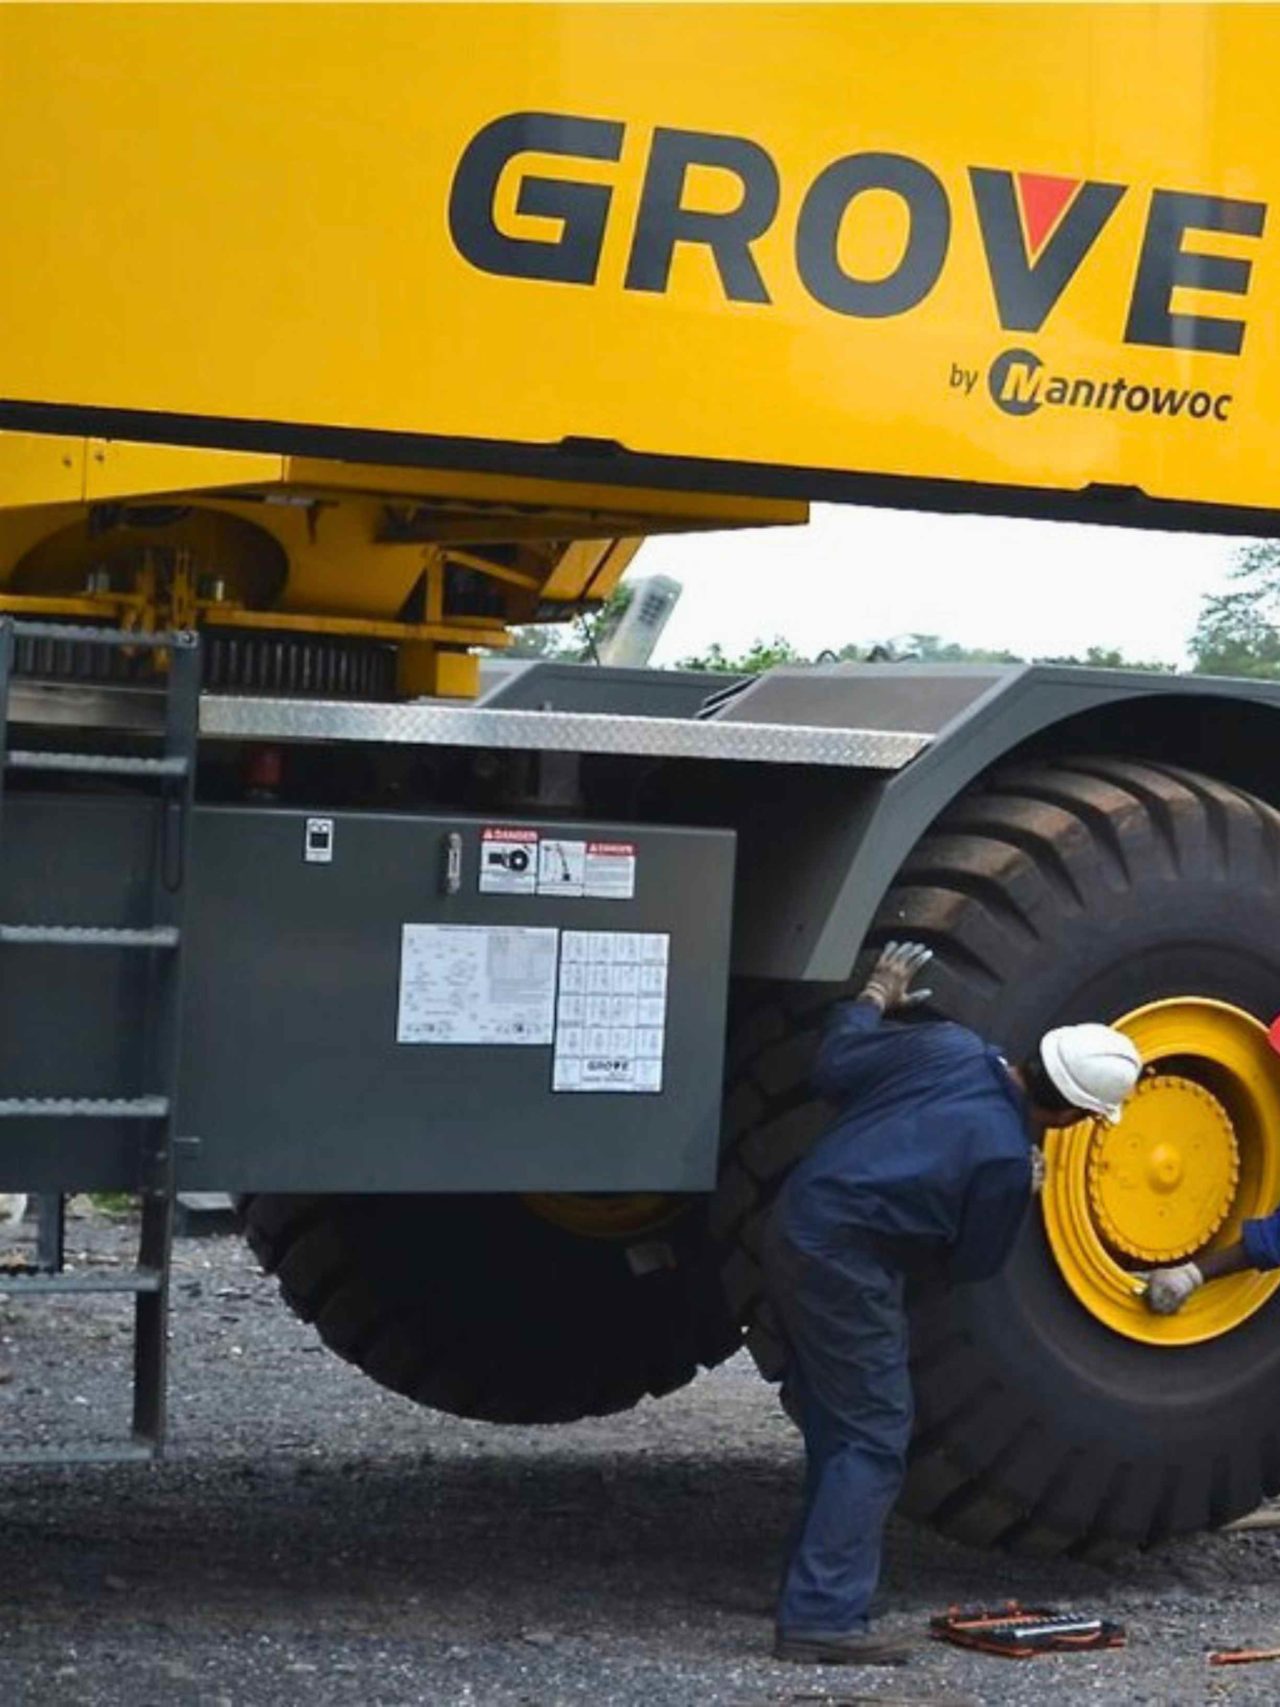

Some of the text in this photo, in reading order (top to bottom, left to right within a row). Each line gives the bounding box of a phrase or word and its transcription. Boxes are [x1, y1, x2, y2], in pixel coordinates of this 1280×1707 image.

[448, 111, 1267, 356] GROVE
[949, 349, 1232, 421] by Manitowoc
